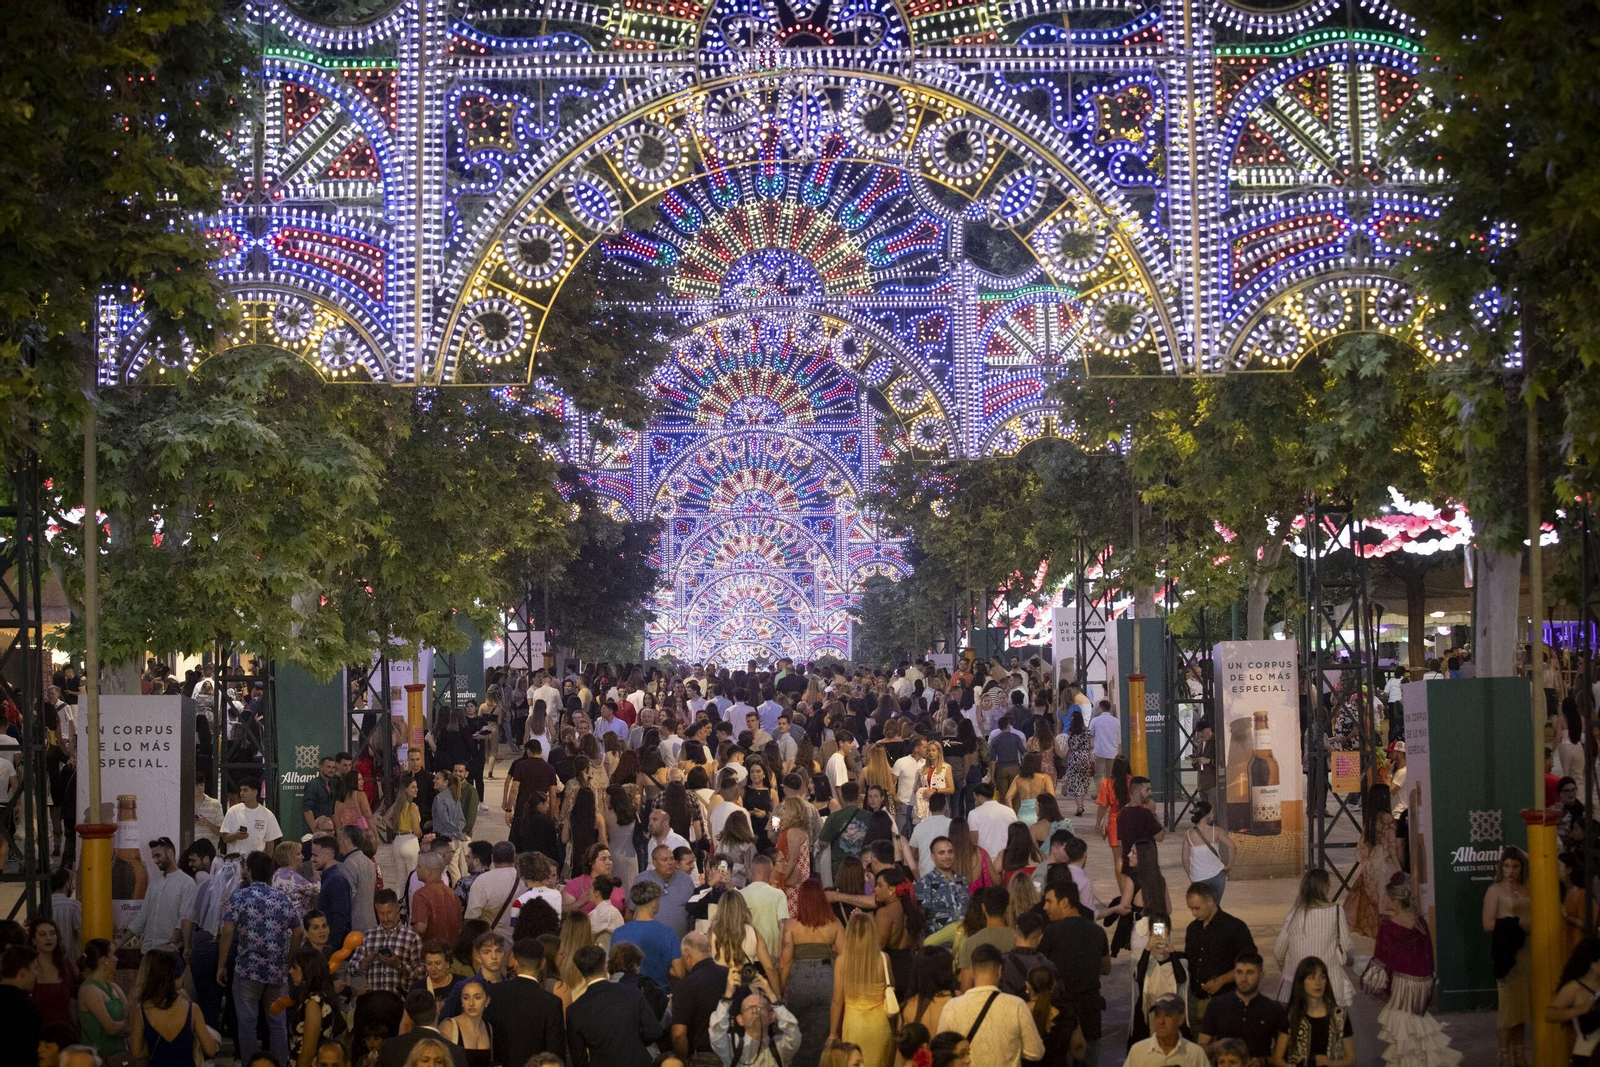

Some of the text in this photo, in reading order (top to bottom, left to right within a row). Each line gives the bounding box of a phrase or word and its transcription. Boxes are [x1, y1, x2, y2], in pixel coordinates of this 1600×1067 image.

[1268, 671, 1290, 680] MÁS
[113, 726, 172, 734] CORPUS
[114, 742, 132, 752] LO
[140, 740, 170, 752] MÁS
[100, 758, 168, 768] SPECIAL.
